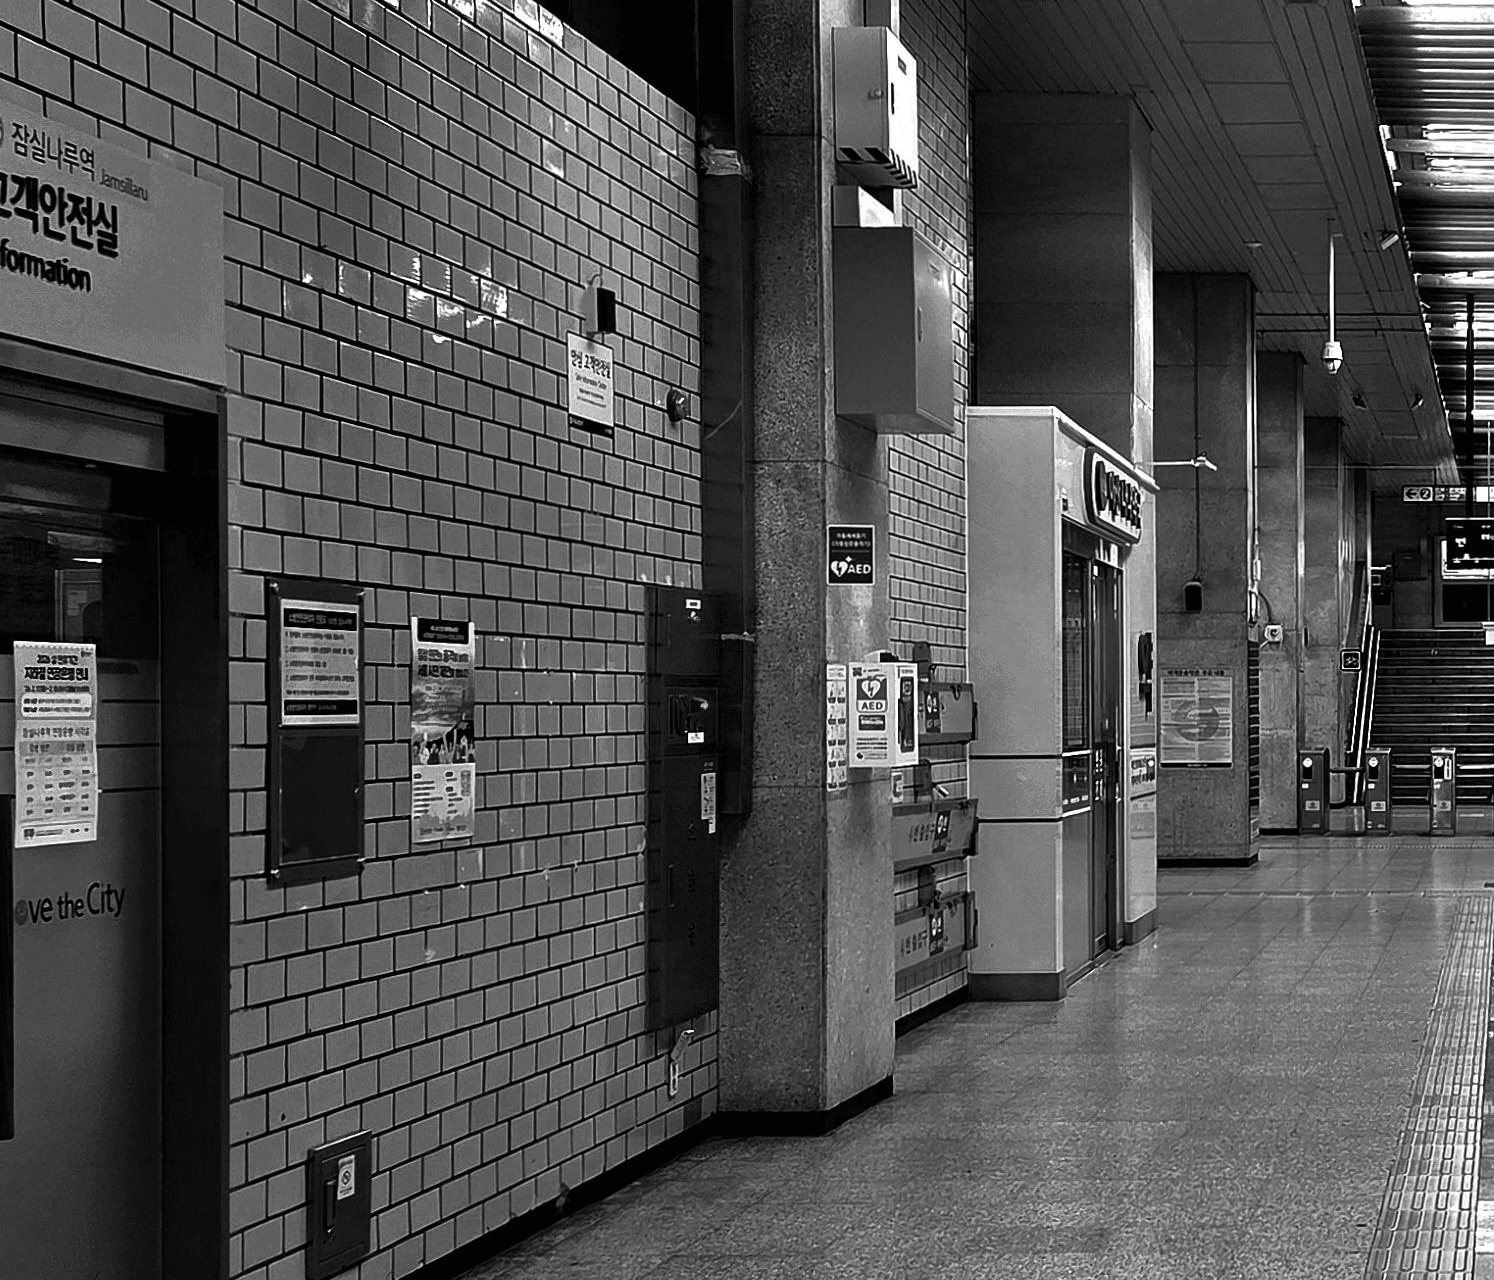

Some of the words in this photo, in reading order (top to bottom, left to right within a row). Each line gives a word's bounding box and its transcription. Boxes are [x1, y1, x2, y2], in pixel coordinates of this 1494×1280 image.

[11, 122, 95, 182] 잠실나루역
[99, 168, 149, 202] Jamsillaru
[847, 563, 872, 575] AED
[861, 701, 883, 711] AED
[57, 891, 85, 920] the
[86, 882, 126, 918] City
